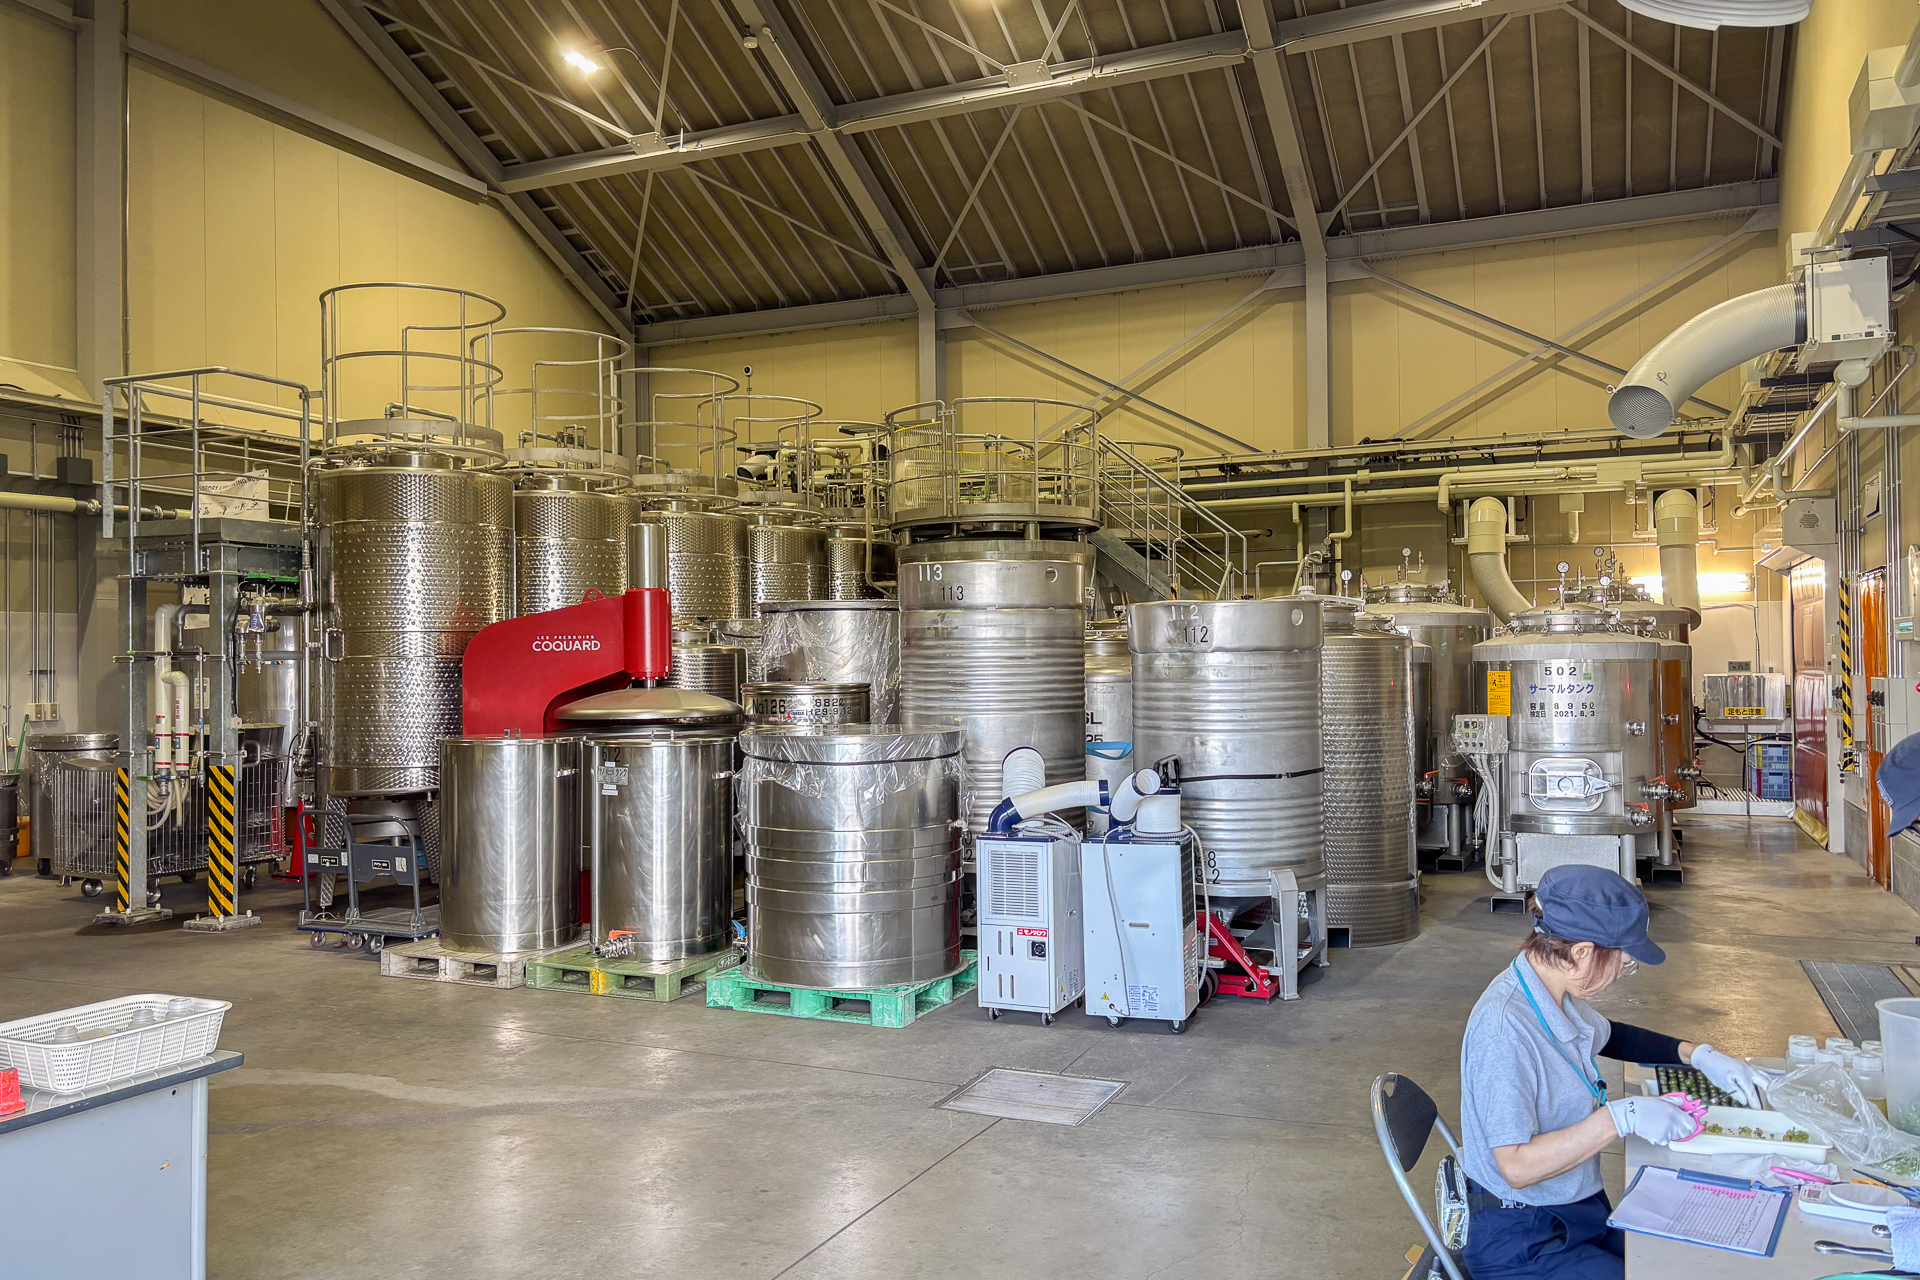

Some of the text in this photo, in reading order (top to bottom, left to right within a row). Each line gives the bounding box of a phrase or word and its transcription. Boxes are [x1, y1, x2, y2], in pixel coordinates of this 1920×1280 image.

[919, 564, 943, 581] 113
[941, 585, 964, 601] 113
[1172, 604, 1199, 620] 112
[1183, 626, 1208, 643] 112
[532, 640, 601, 652] COQUARD
[1544, 666, 1577, 676] 502
[1529, 683, 1594, 694] サーマルタンク
[1728, 708, 1762, 716] 足もと注意
